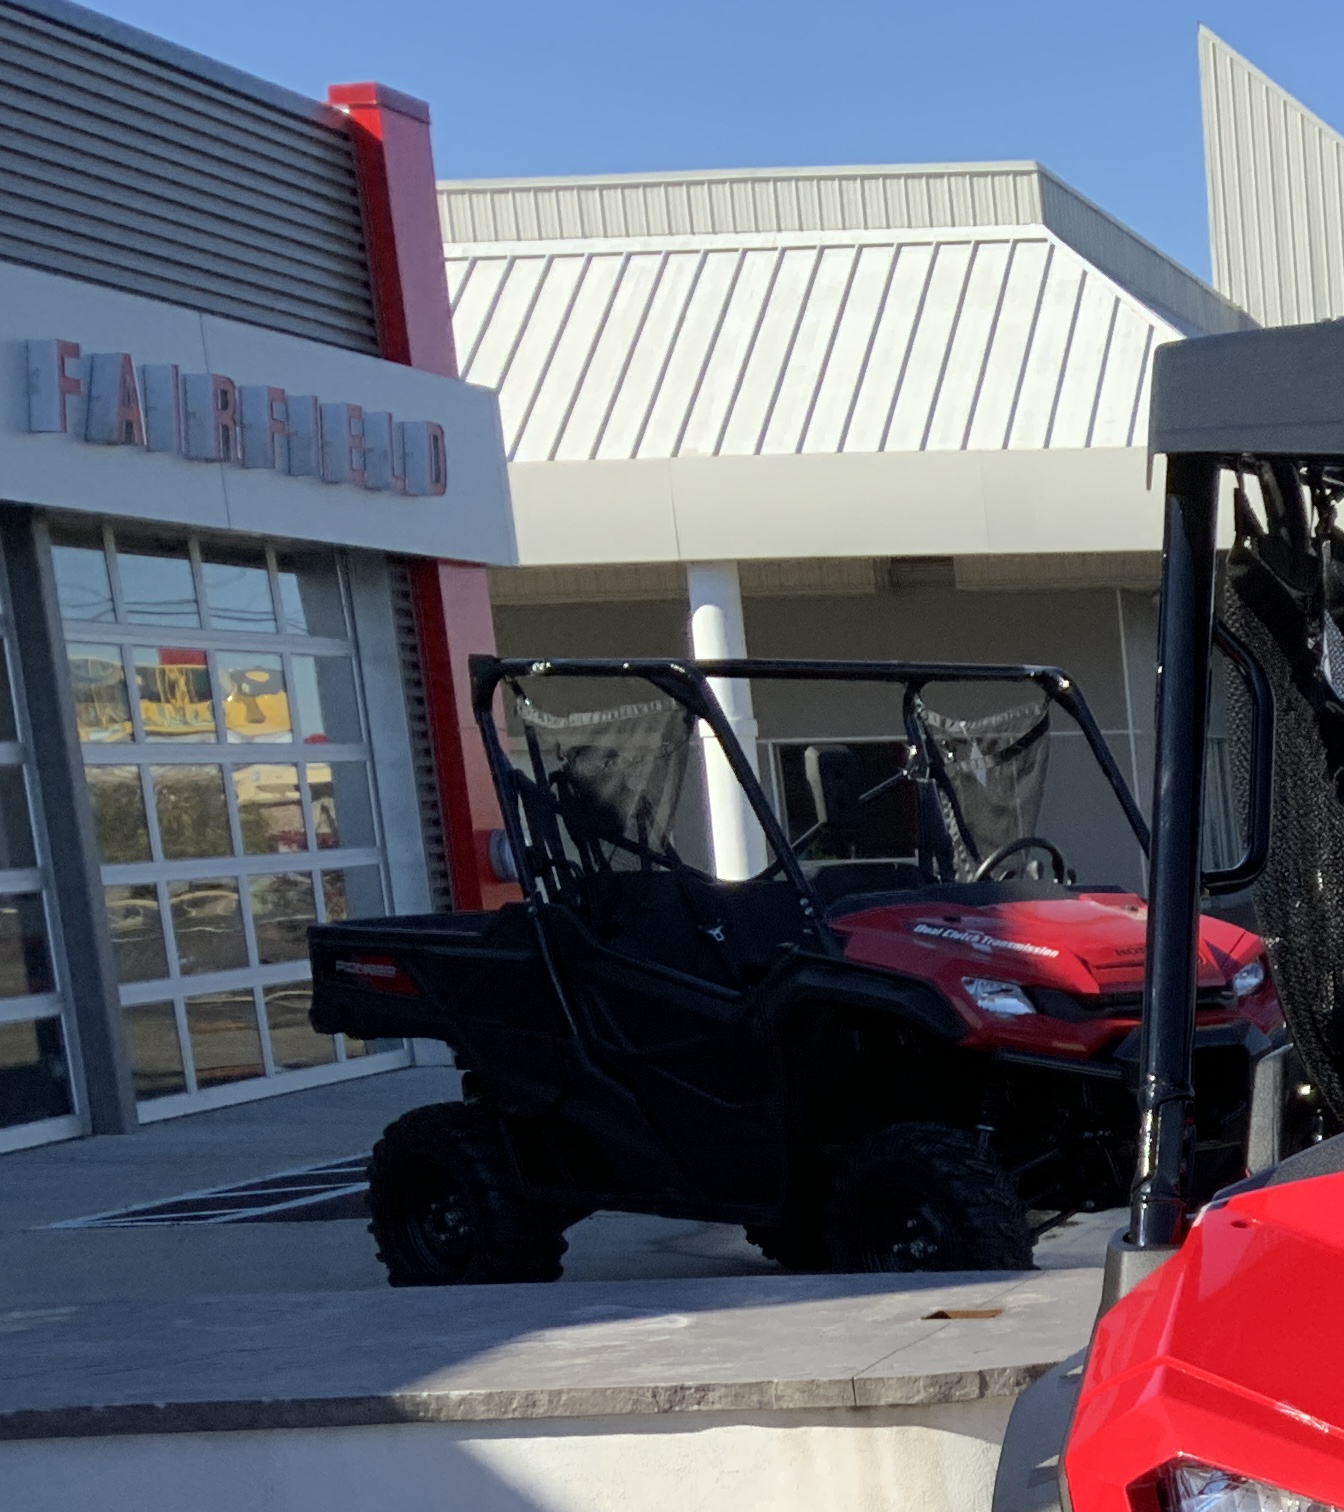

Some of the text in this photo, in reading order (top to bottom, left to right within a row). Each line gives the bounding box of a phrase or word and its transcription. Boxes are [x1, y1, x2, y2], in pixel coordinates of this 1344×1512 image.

[27, 339, 447, 497] FAIRFIELD
[913, 923, 1060, 958] Dual Clutch Transmission
